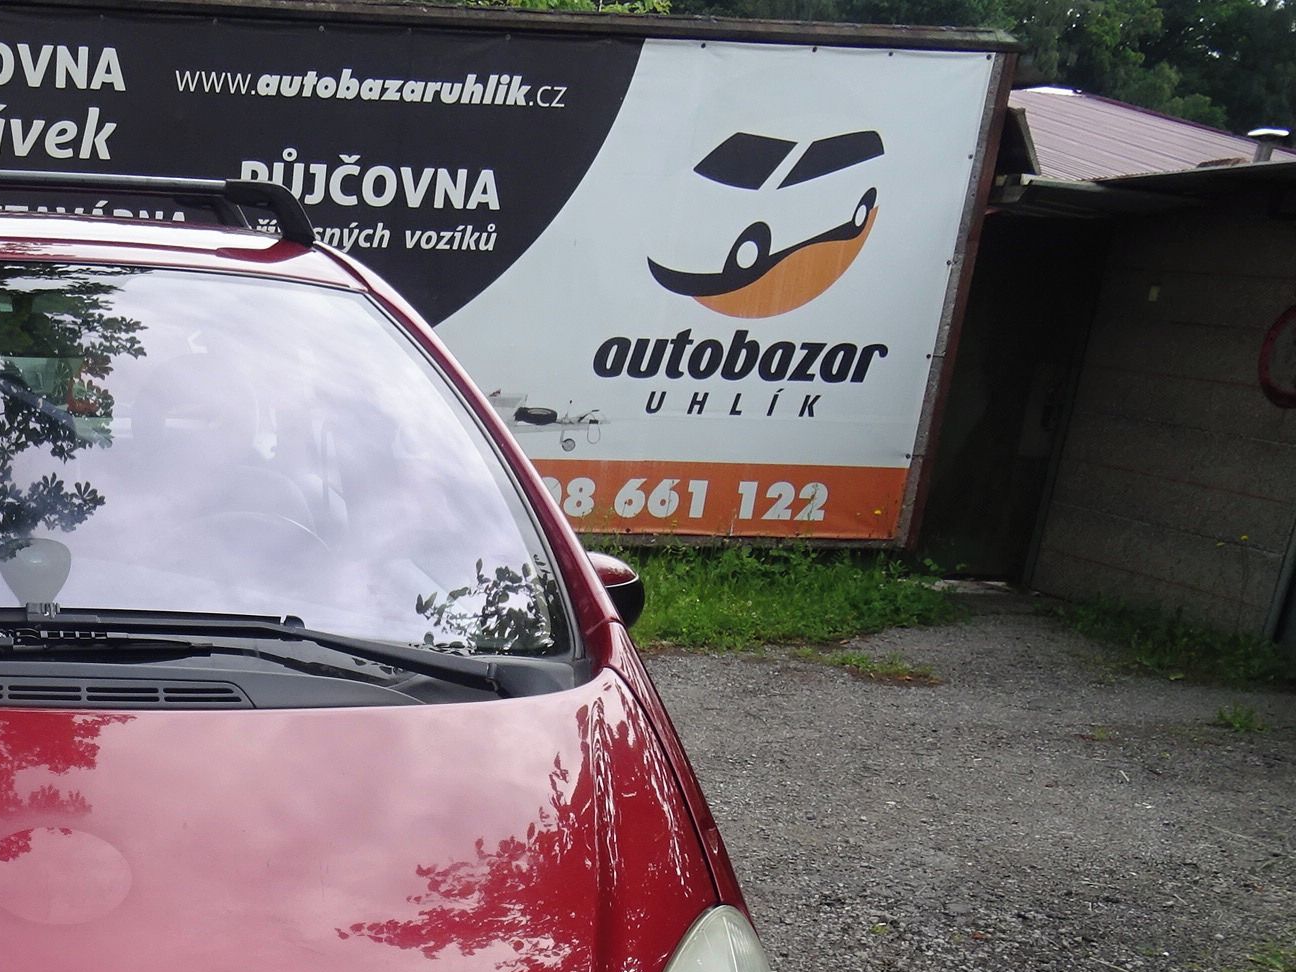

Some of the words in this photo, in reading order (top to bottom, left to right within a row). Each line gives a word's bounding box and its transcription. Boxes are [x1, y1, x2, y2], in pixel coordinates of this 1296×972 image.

[175, 68, 568, 108] www.autobazaruhlik.cz
[404, 223, 498, 252] vozíků
[592, 328, 889, 384] autobazar
[644, 387, 822, 418] UHLÍK
[613, 477, 709, 519] 661
[737, 480, 829, 522] 122
